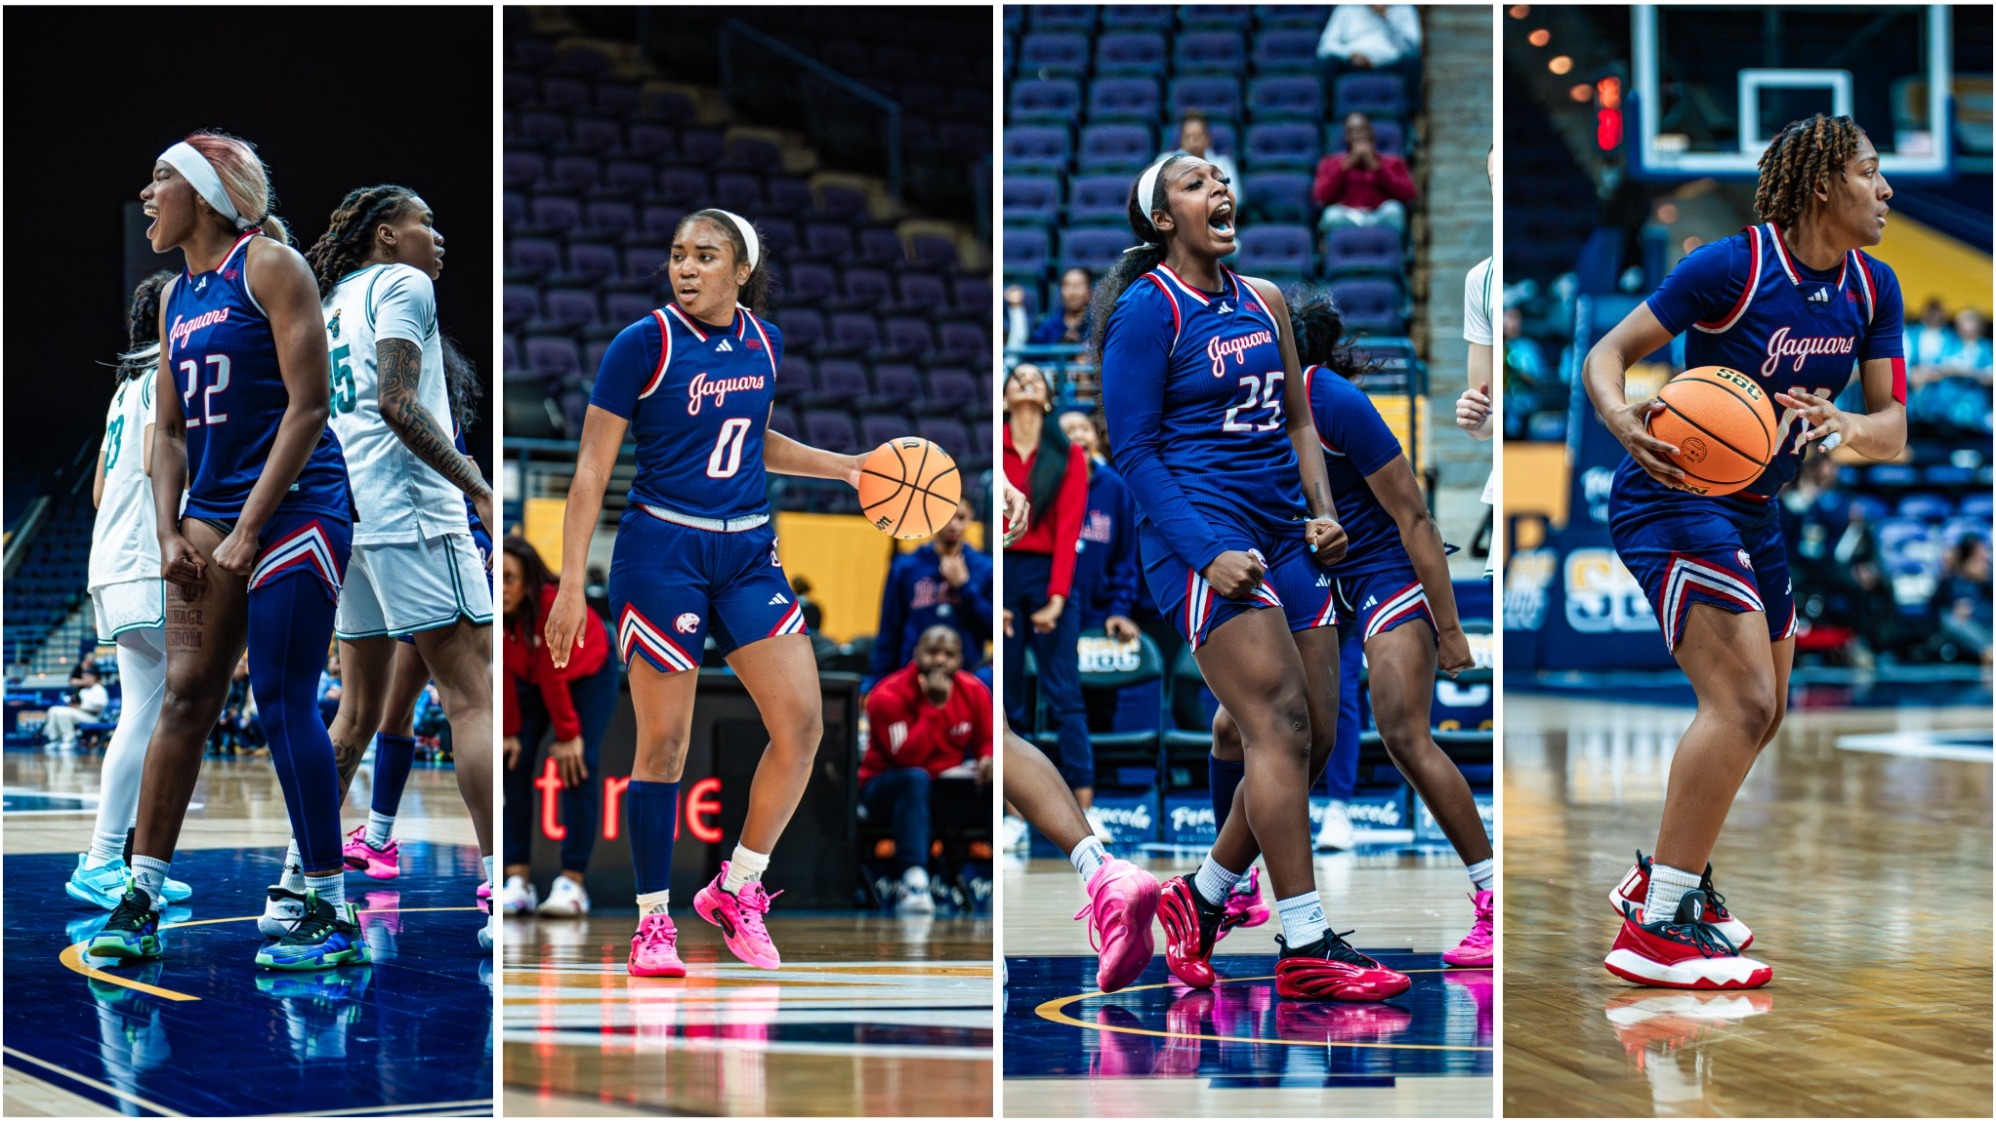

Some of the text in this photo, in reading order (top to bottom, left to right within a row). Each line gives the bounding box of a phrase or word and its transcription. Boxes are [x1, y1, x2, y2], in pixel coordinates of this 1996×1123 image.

[168, 307, 231, 361] Jaguars
[1207, 330, 1273, 378] Jaguars
[1760, 326, 1856, 378] Jaguars
[178, 353, 232, 429] 22
[687, 372, 766, 416] Jaguars
[1222, 370, 1285, 432] 25
[1716, 368, 1763, 401] SBC
[706, 417, 752, 479] 0
[1564, 548, 1662, 633] SB
[533, 756, 725, 844] tre
